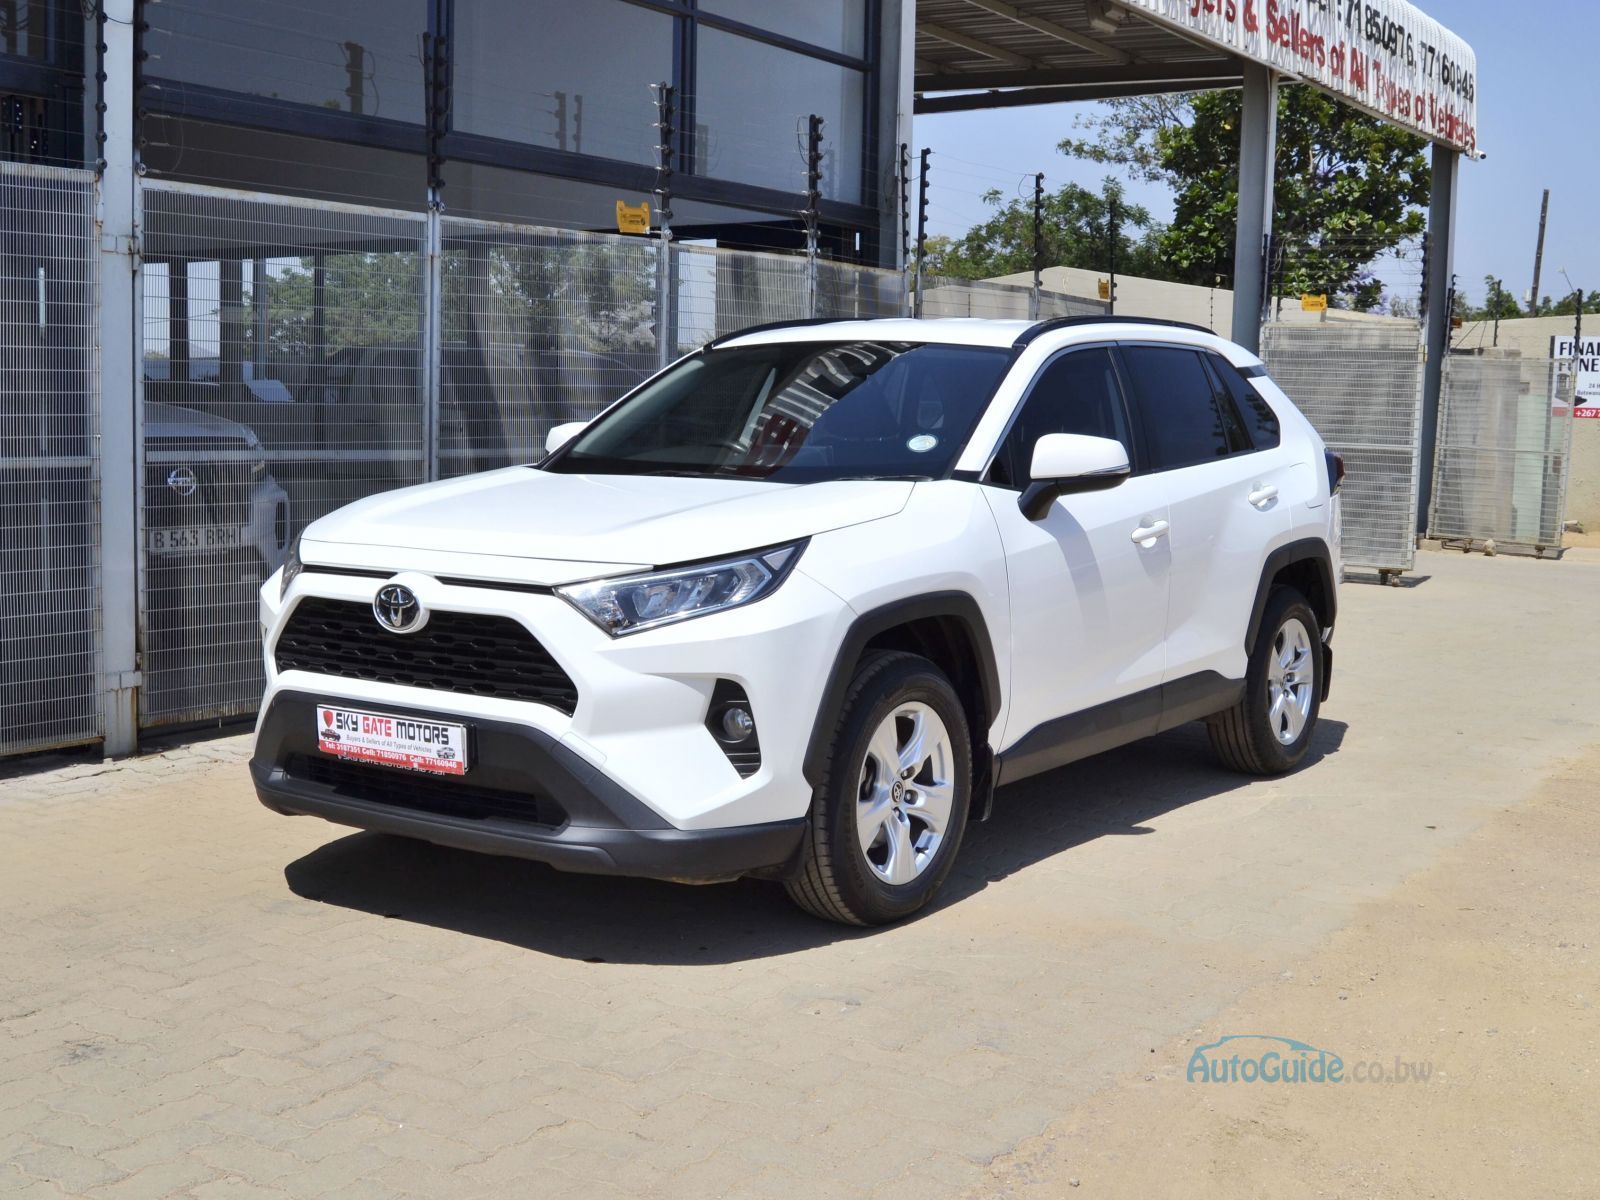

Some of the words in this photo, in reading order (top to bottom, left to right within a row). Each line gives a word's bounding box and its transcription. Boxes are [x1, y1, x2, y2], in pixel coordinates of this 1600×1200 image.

[1266, 0, 1325, 67] Sellers
[1330, 40, 1345, 80] of
[336, 712, 358, 732] SKY
[362, 716, 392, 737] GATE
[396, 721, 449, 746] MOTORS
